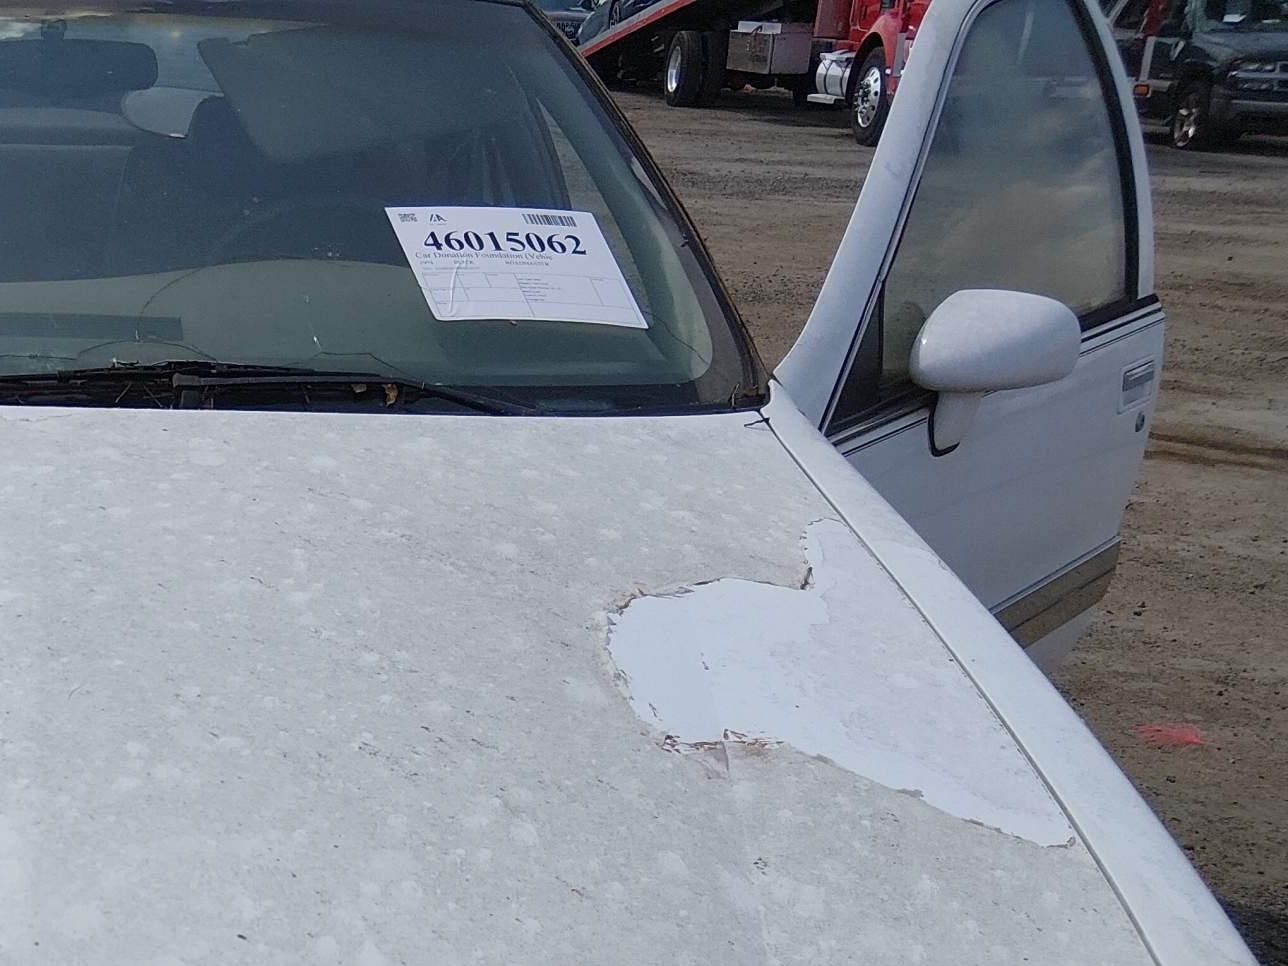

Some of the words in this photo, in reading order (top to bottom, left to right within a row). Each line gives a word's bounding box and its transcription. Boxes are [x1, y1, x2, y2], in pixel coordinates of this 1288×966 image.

[424, 230, 587, 256] 46015062
[415, 251, 431, 259] Car
[433, 251, 474, 259] Donation
[474, 252, 523, 260] Foundation
